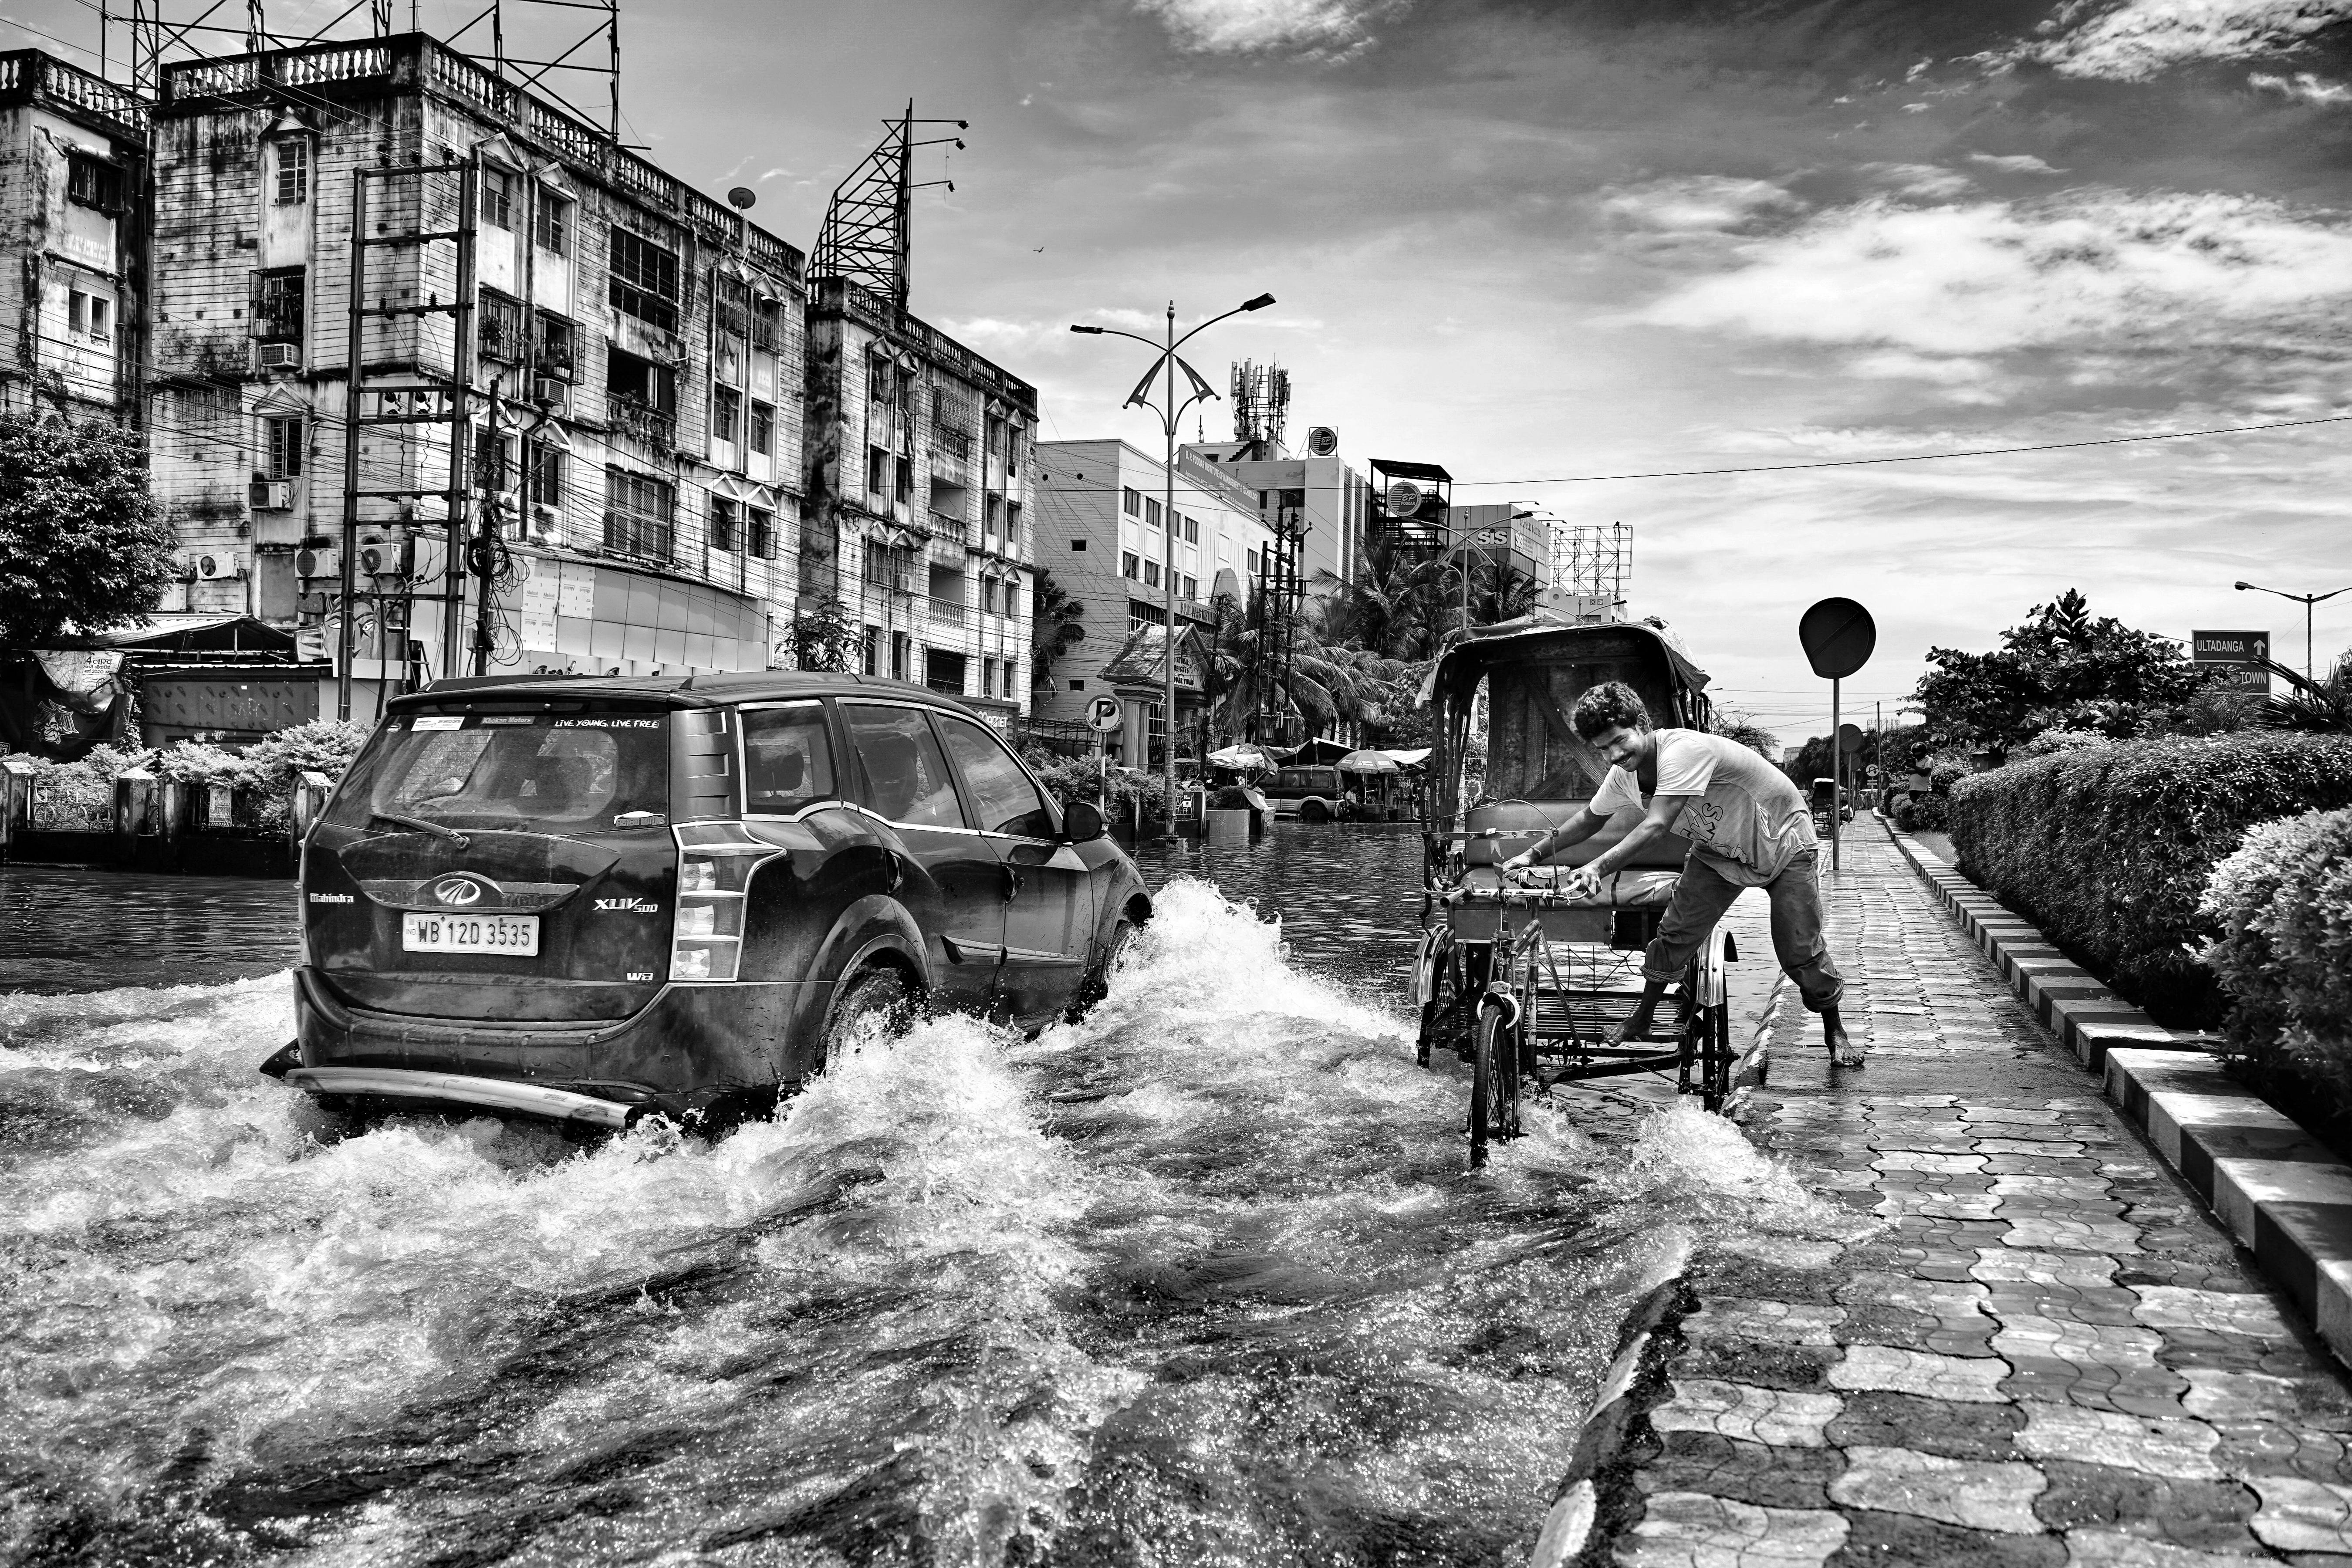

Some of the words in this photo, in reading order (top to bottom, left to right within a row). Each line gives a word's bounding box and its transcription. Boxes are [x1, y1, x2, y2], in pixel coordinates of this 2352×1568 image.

[1186, 450, 1189, 460] B.
[1190, 453, 1193, 462] P.
[1193, 454, 1205, 470] PODDAR
[1205, 462, 1219, 478] INSTITUTE
[1219, 471, 1223, 480] OF
[1402, 493, 1416, 501] BP
[2197, 640, 2244, 652] ULTADANGA
[2240, 672, 2266, 684] TOWN
[1096, 700, 1116, 726] P
[633, 720, 659, 728] FREE
[1085, 713, 1102, 733] BIDHANNAGAR
[309, 893, 354, 903] Mahindra
[592, 898, 658, 912] XUV500
[417, 920, 439, 943] WB
[448, 922, 480, 944] 12D
[487, 923, 531, 946] 3535
